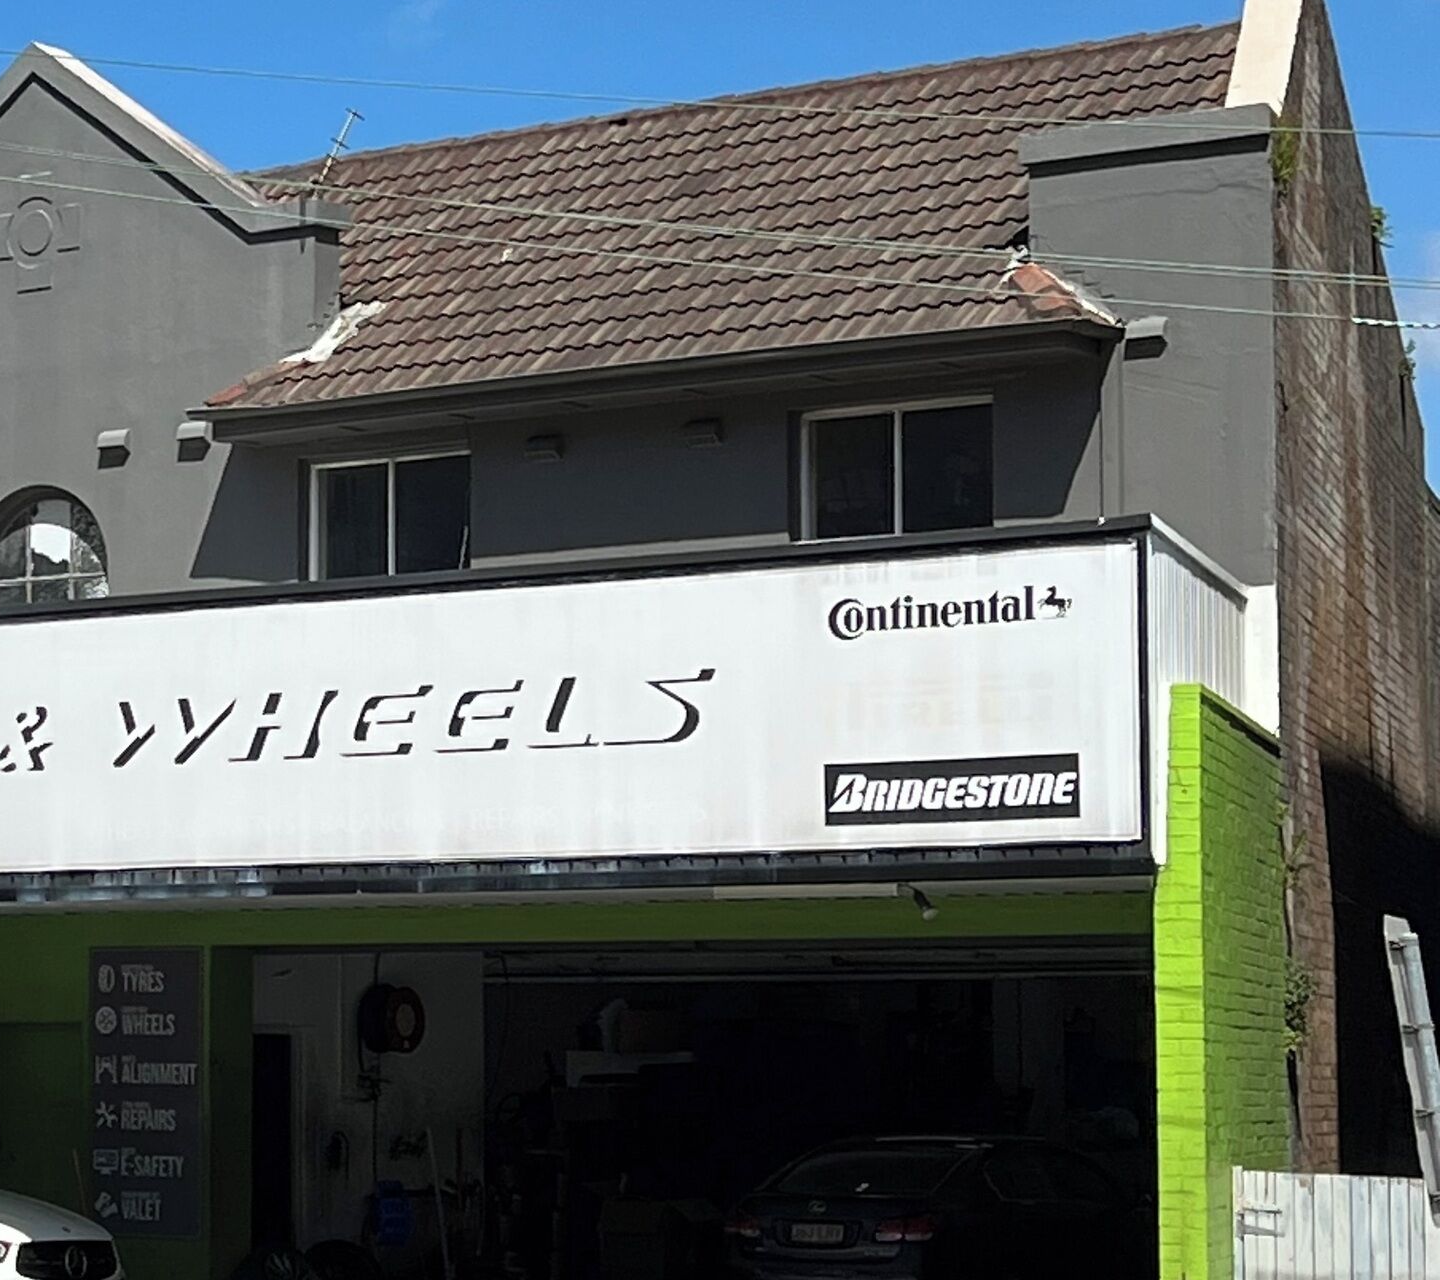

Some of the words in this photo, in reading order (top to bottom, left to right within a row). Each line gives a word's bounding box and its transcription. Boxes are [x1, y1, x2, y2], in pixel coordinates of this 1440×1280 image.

[828, 585, 1036, 641] Continental
[112, 668, 716, 768] WHEELS
[828, 771, 1078, 813] BRIDGESTONE
[122, 970, 165, 993] TYRES
[121, 1013, 176, 1036] WHEELS
[120, 1062, 198, 1085] ALIGNMENT
[120, 1108, 177, 1132] REPAIRS
[120, 1154, 185, 1179] E-SAFETY
[121, 1198, 162, 1221] VALET
